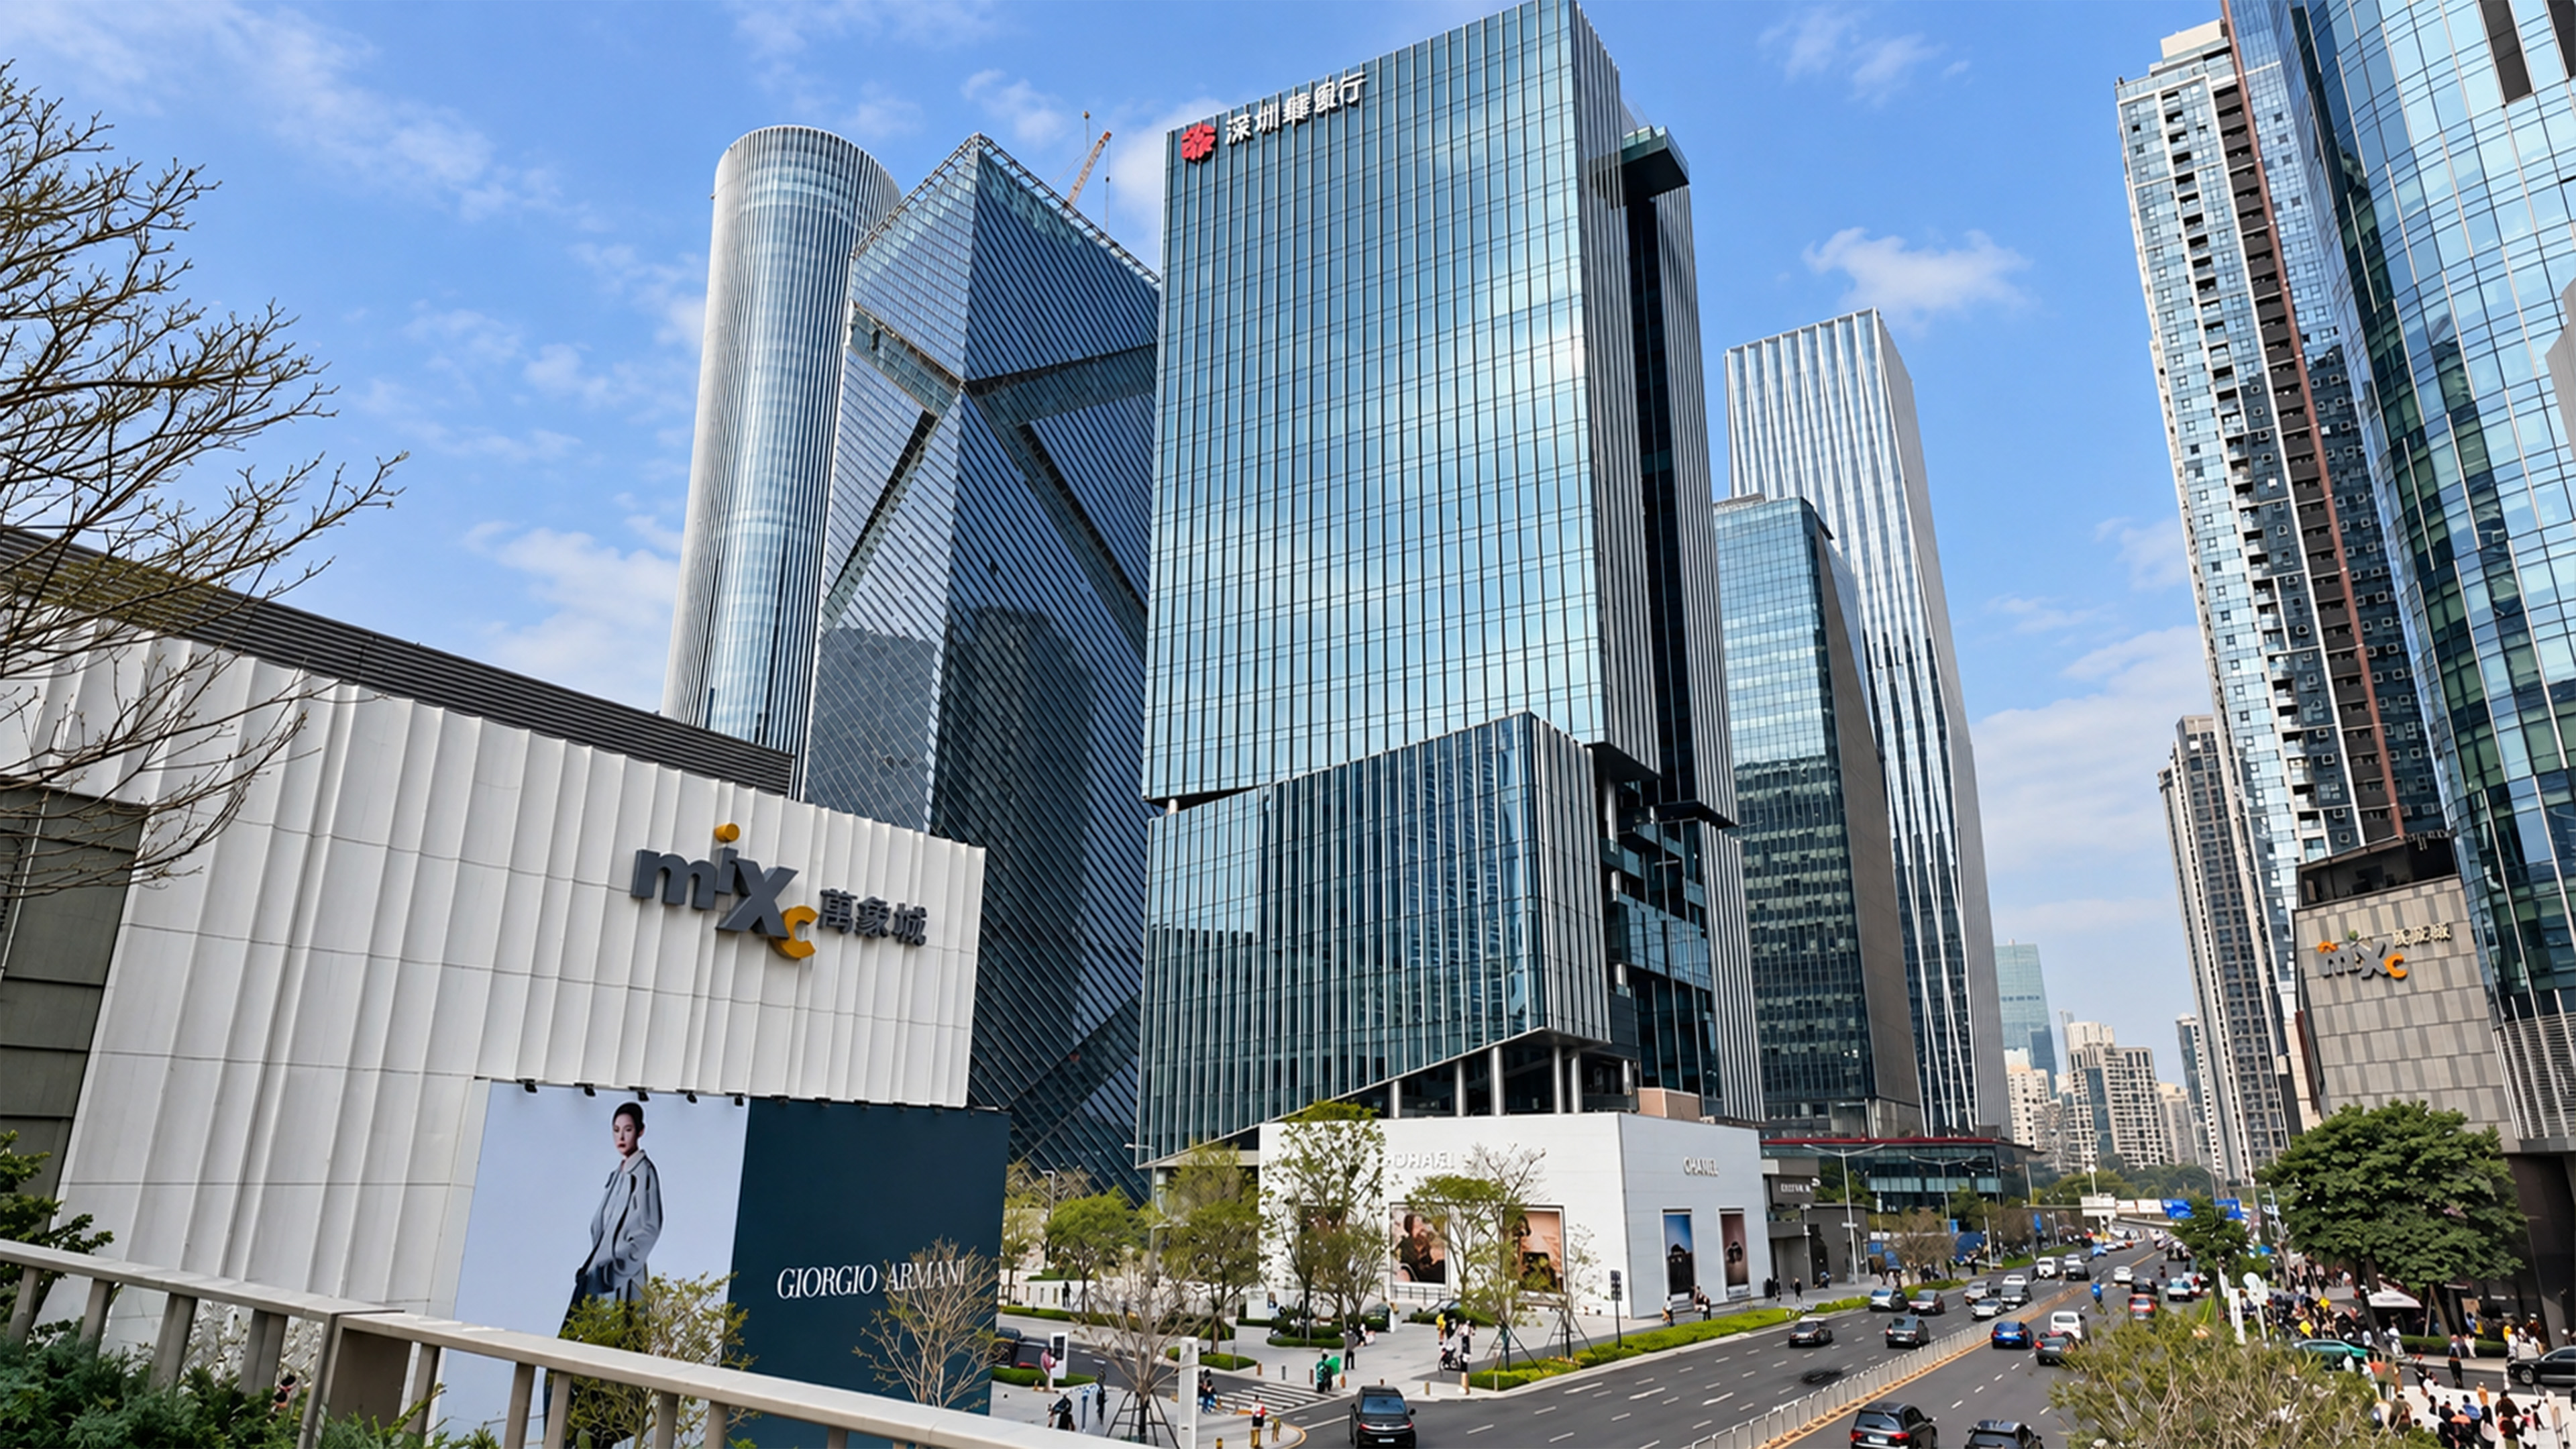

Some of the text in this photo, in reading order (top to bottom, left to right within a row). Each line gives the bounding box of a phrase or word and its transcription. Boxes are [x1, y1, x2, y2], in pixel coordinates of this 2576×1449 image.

[817, 888, 927, 947] 萬象城
[777, 1258, 966, 1299] GIORGIO ARMANI
